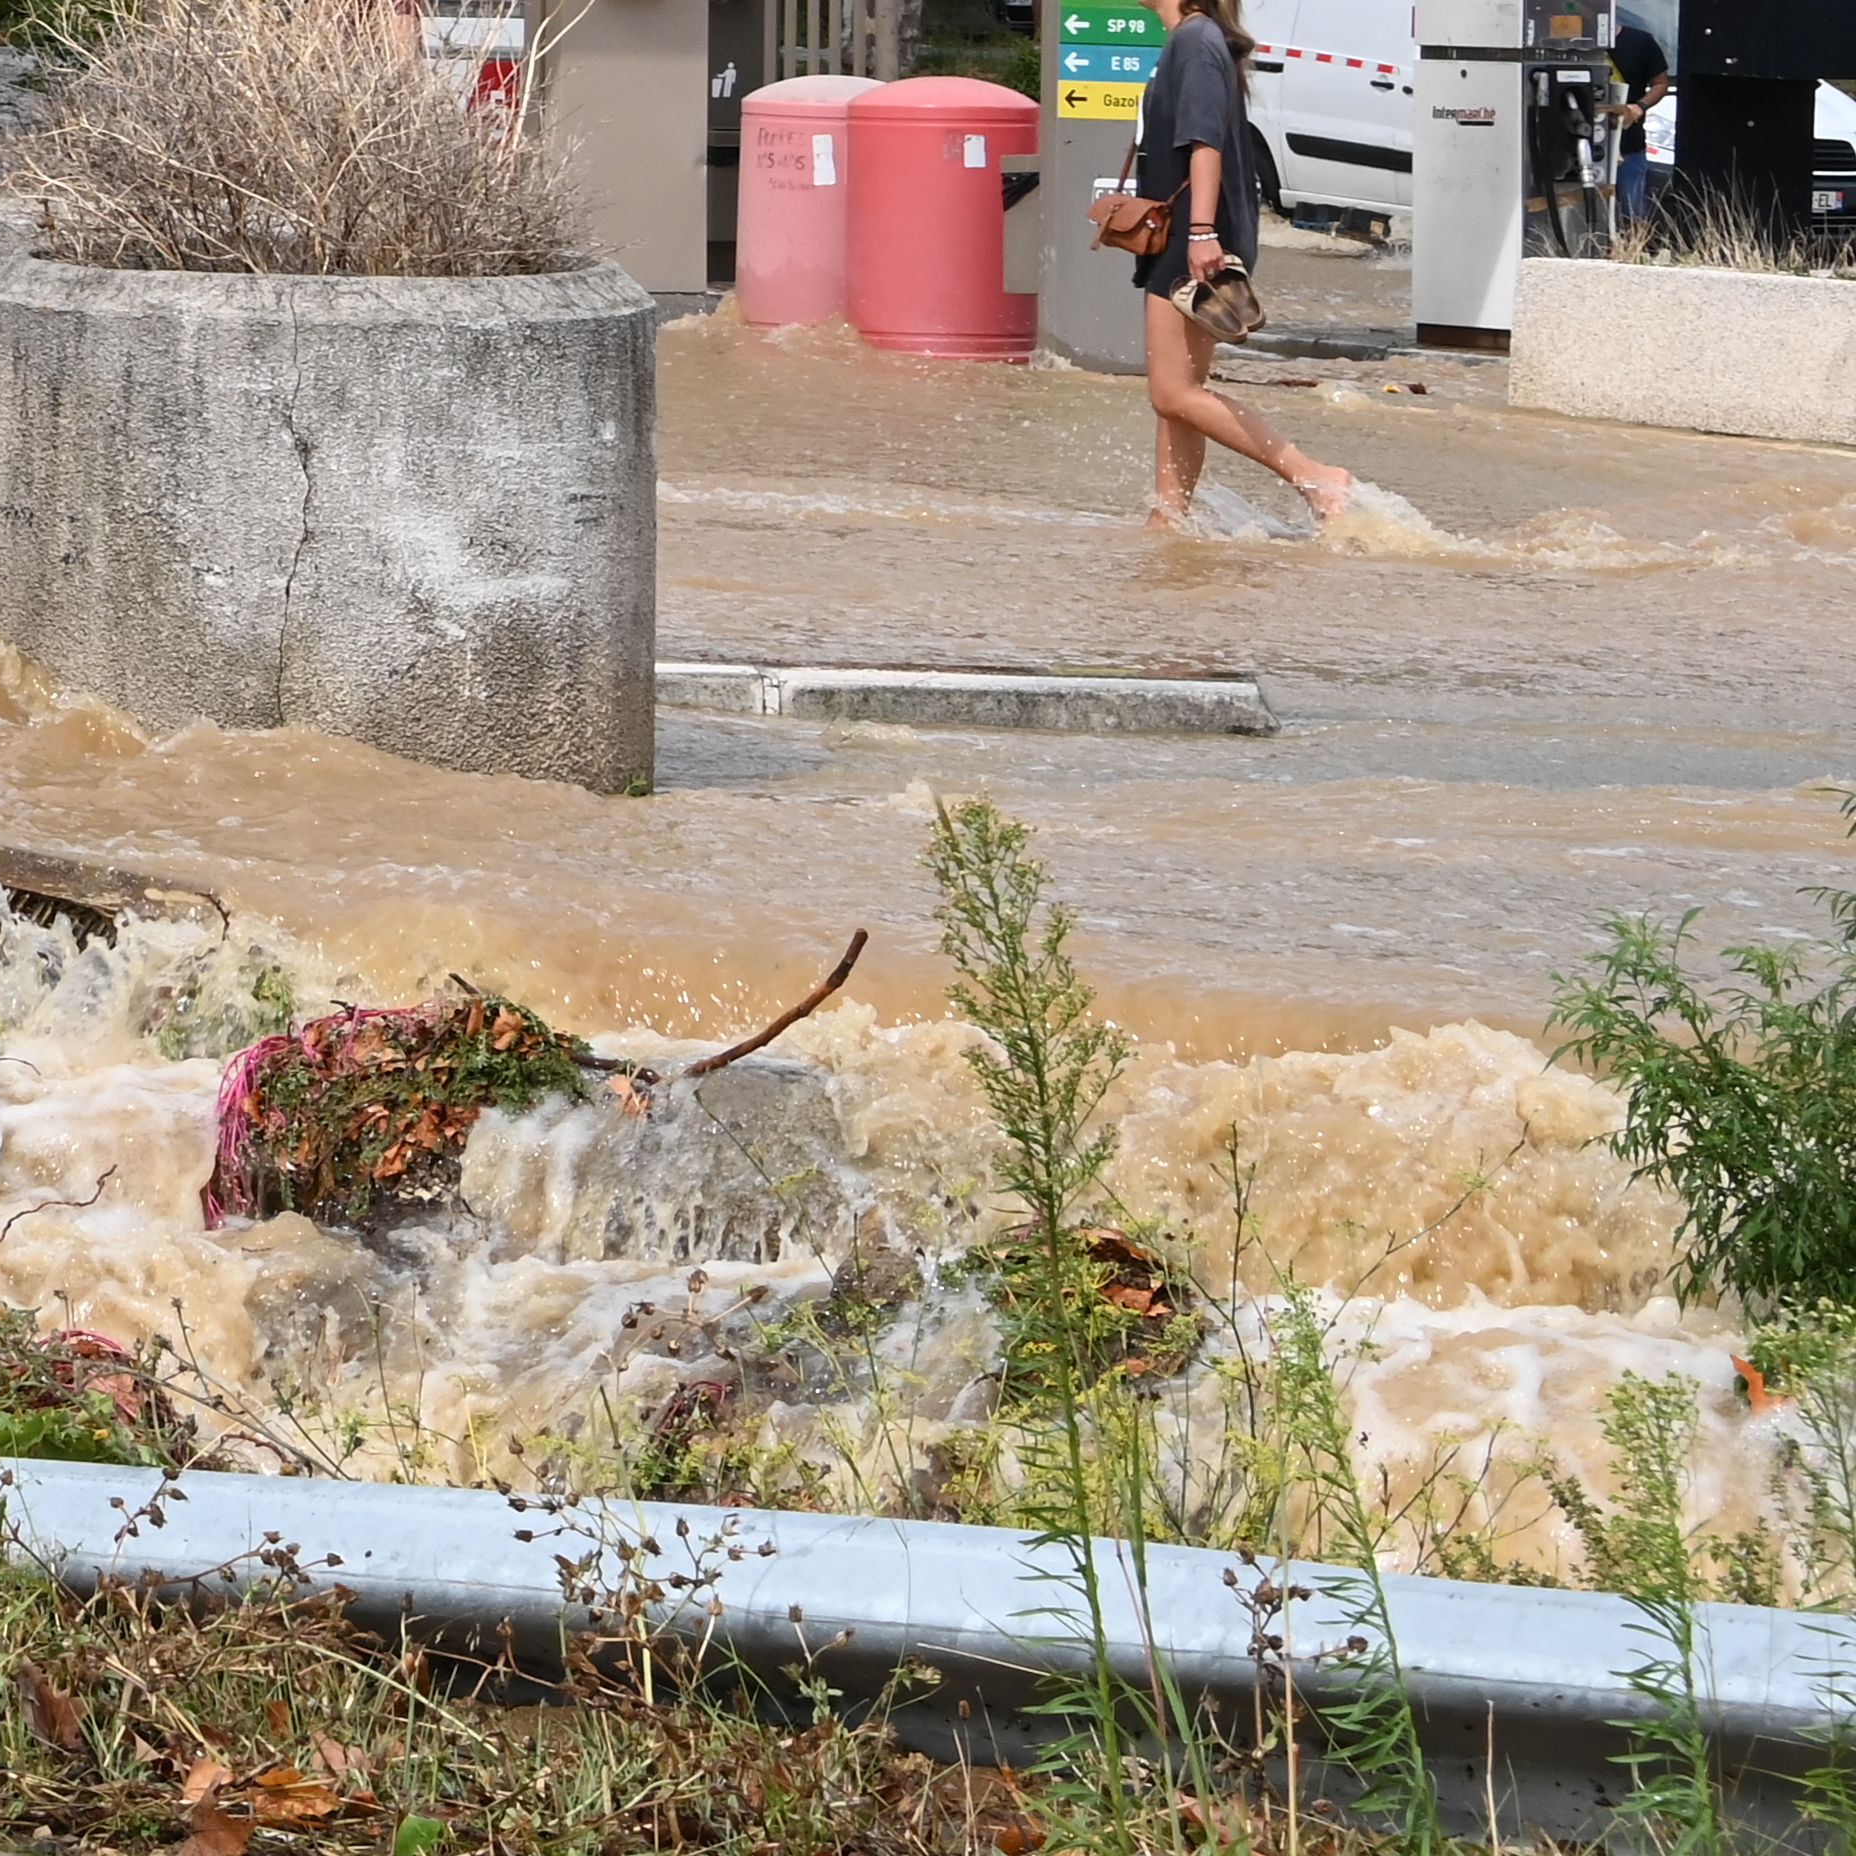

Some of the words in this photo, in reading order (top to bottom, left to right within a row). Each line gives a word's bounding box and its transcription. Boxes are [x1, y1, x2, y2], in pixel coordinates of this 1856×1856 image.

[1107, 19, 1127, 33] SP
[1129, 19, 1146, 34] 98
[1111, 56, 1122, 71] E
[1124, 56, 1140, 72] 85
